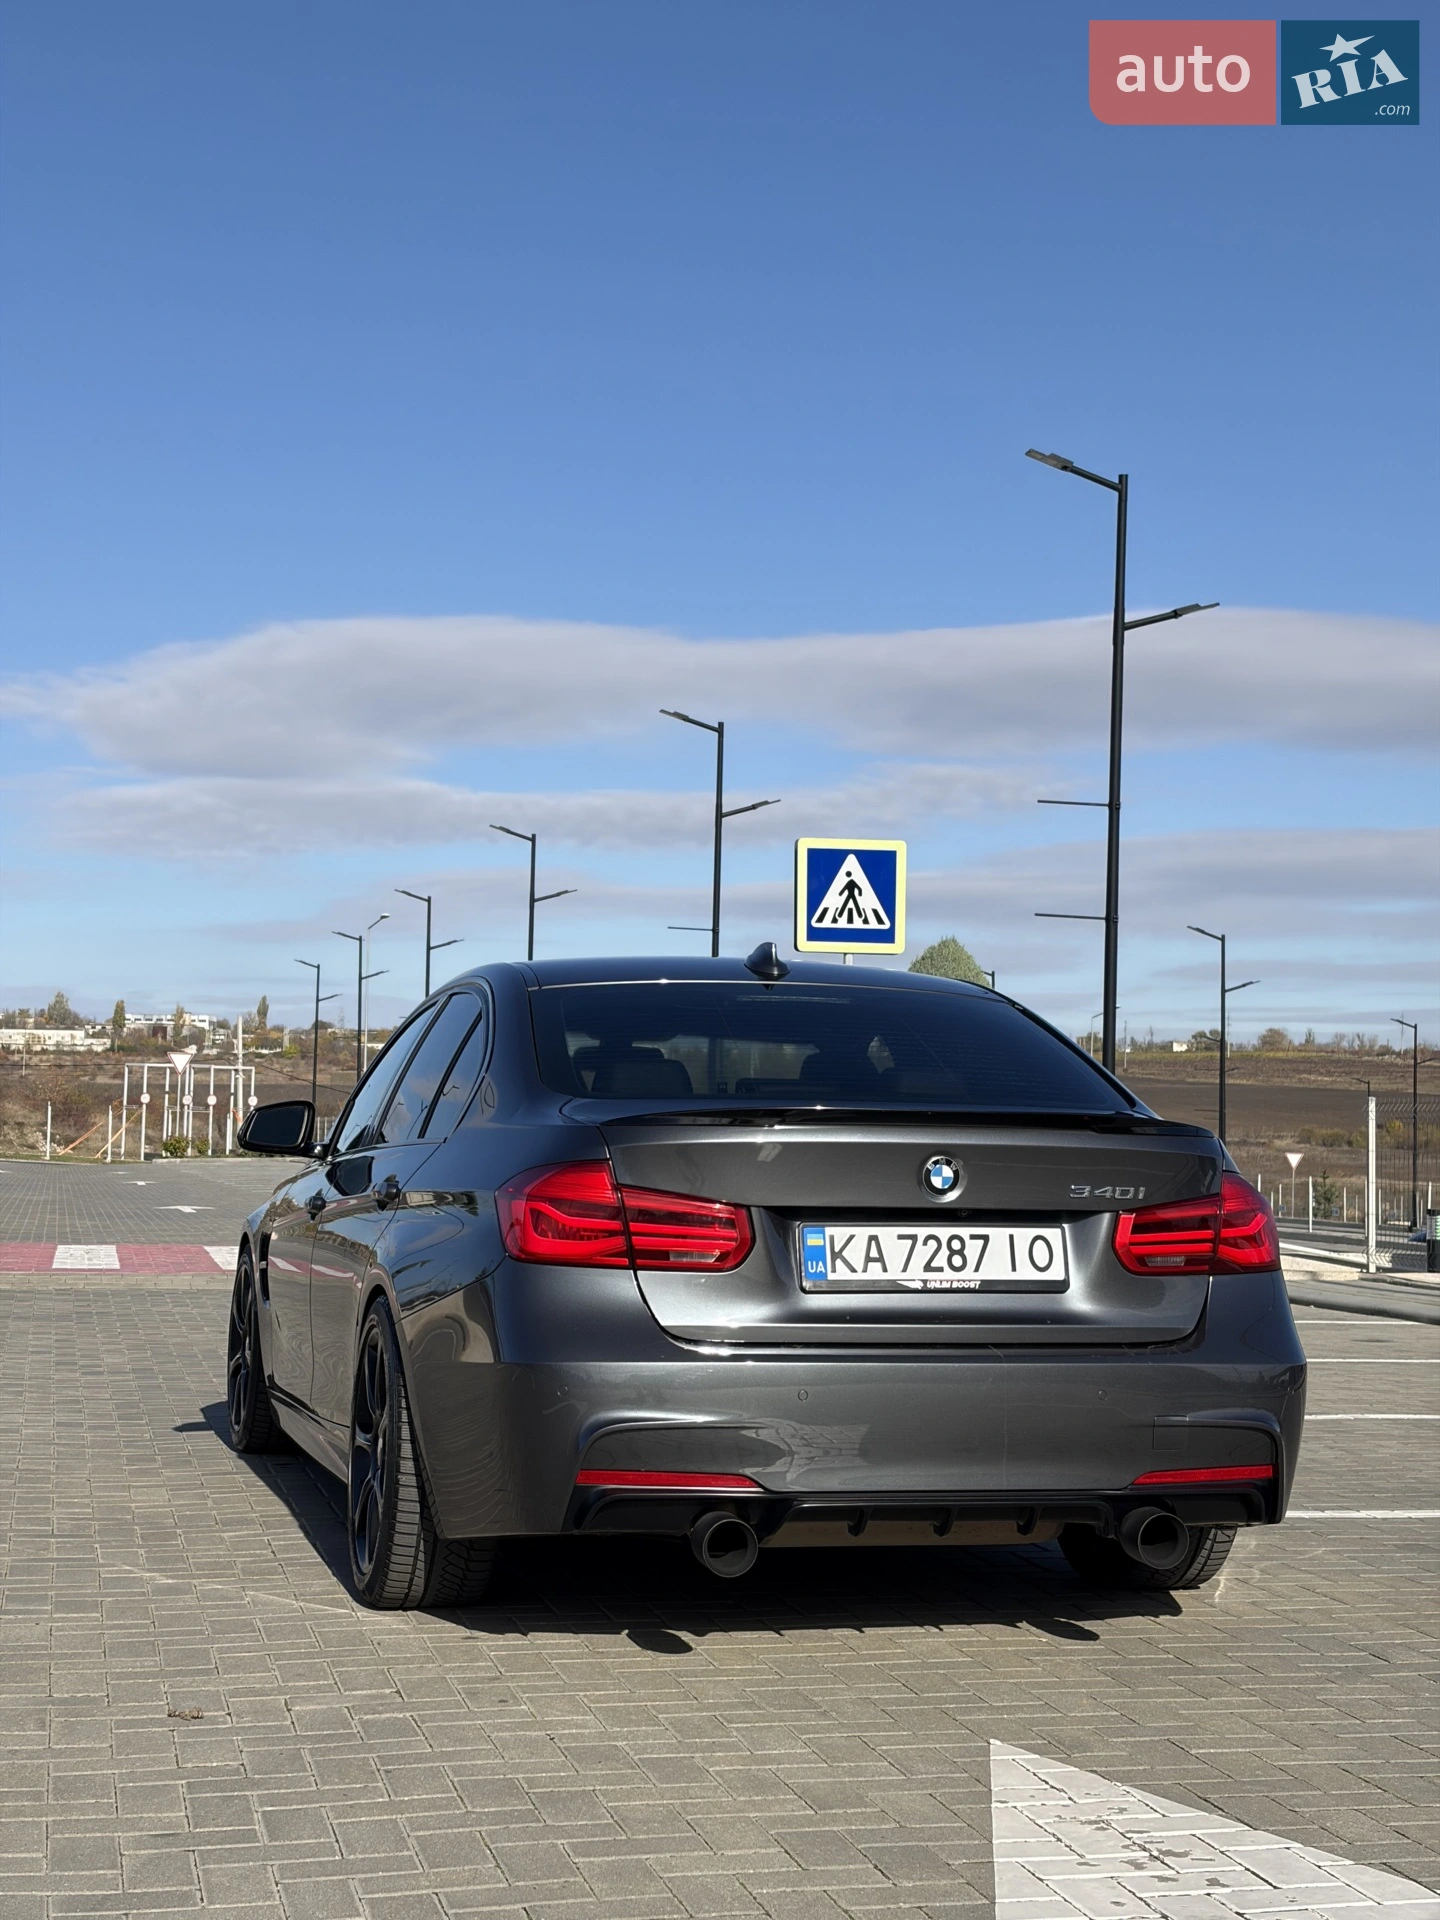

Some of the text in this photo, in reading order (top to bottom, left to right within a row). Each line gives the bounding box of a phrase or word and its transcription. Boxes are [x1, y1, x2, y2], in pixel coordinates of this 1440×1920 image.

[927, 1158, 957, 1170] BMW
[829, 1234, 1054, 1273] KA 7287 IO
[808, 1261, 826, 1274] UA
[952, 1280, 981, 1290] BOOST
